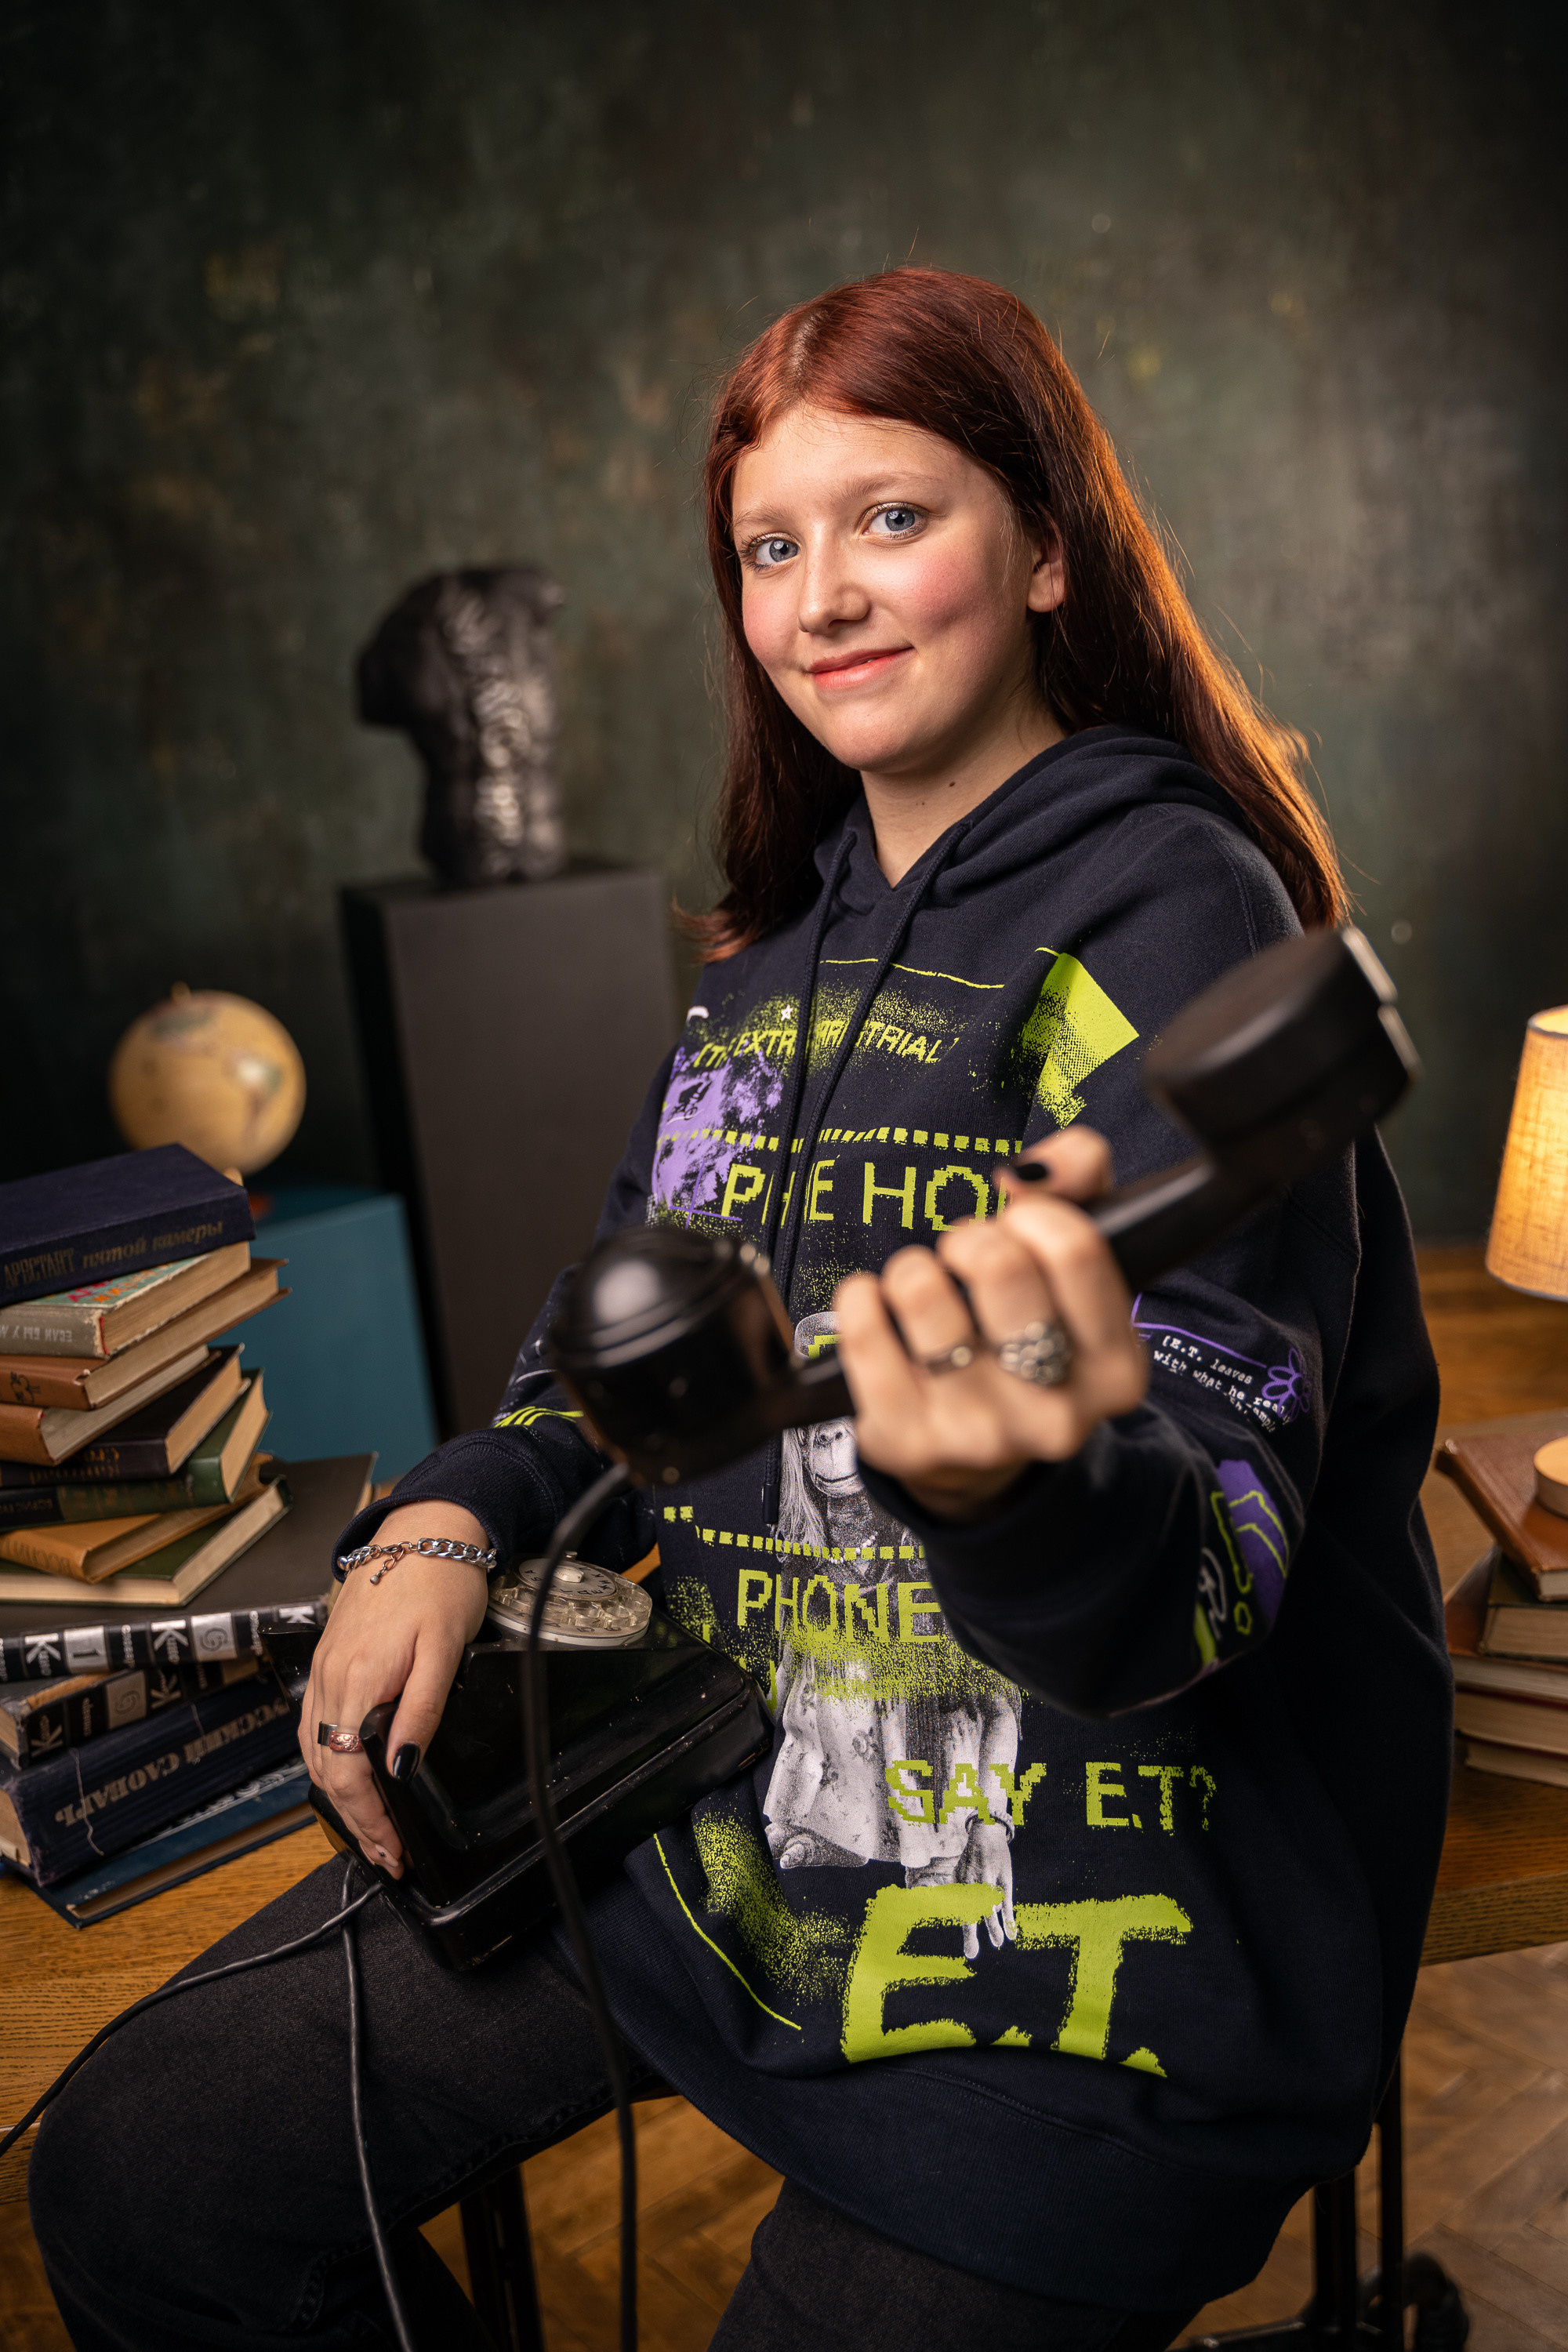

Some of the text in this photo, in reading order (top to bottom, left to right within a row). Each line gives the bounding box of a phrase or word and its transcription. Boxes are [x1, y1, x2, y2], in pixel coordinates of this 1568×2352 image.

[1153, 1350, 1187, 1373] with
[1192, 1370, 1222, 1390] what
[1228, 1385, 1246, 1400] he
[1210, 1359, 1253, 1385] leaves
[737, 1569, 942, 1643] PHONE
[54, 1697, 289, 1828] УССКИЙ СЛОВАРЬ
[885, 1760, 1047, 1825] SAY
[840, 1882, 1193, 2078] E.T.
